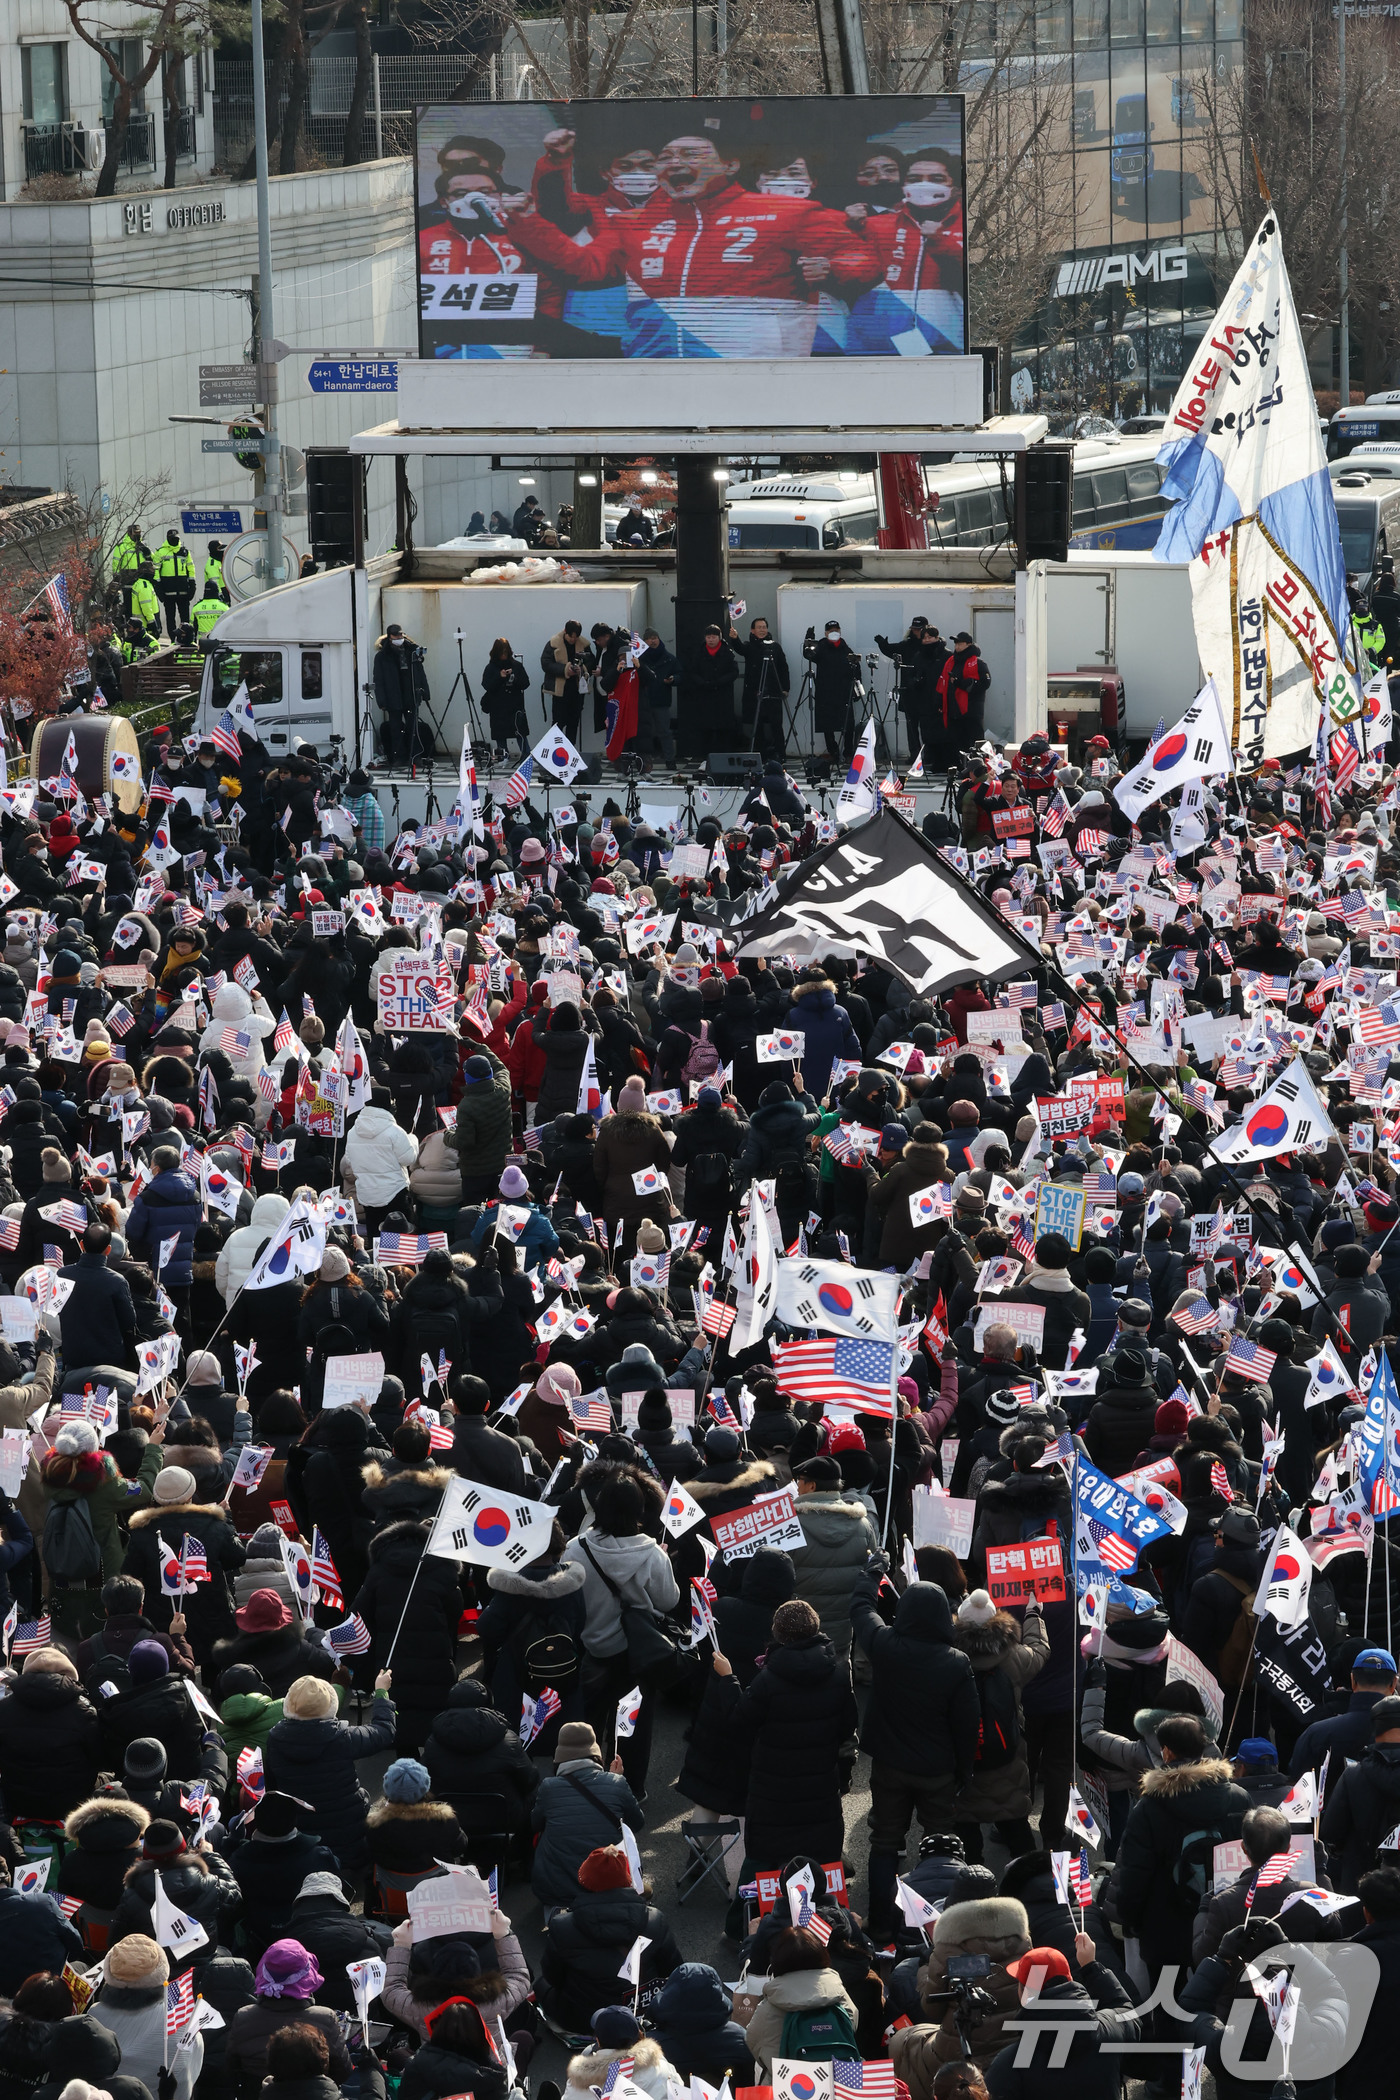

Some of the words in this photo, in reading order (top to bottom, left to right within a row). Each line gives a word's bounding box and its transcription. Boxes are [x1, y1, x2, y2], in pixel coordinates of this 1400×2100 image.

[126, 204, 152, 234] 한남
[169, 203, 227, 228] OFFICETEL
[722, 226, 758, 263] 2
[1097, 247, 1188, 291] AMG
[324, 381, 392, 390] Hannam-daero
[315, 915, 344, 923] 부정선거
[394, 960, 431, 973] 탄핵무효
[397, 997, 433, 1012] THE
[383, 1011, 447, 1029] STEAL
[326, 1074, 340, 1084] STOP
[327, 1083, 338, 1092] THE
[1072, 1084, 1096, 1098] 탄핵
[1099, 1082, 1123, 1097] 반대
[323, 1089, 339, 1100] STEAL
[1039, 1094, 1091, 1121] 불법영장
[1041, 1112, 1092, 1138] 원천무효
[1040, 1186, 1083, 1210] STOP
[1044, 1206, 1076, 1227] THE
[274, 1506, 294, 1526] 반대
[715, 1496, 794, 1549] 탄핵반대
[769, 1523, 801, 1546] 구속
[988, 1550, 1026, 1575] 탄핵
[1030, 1544, 1062, 1568] 반대
[991, 1580, 1036, 1599] 이재명
[1038, 1576, 1064, 1594] 구속
[1259, 1657, 1316, 1715] 구국동지회
